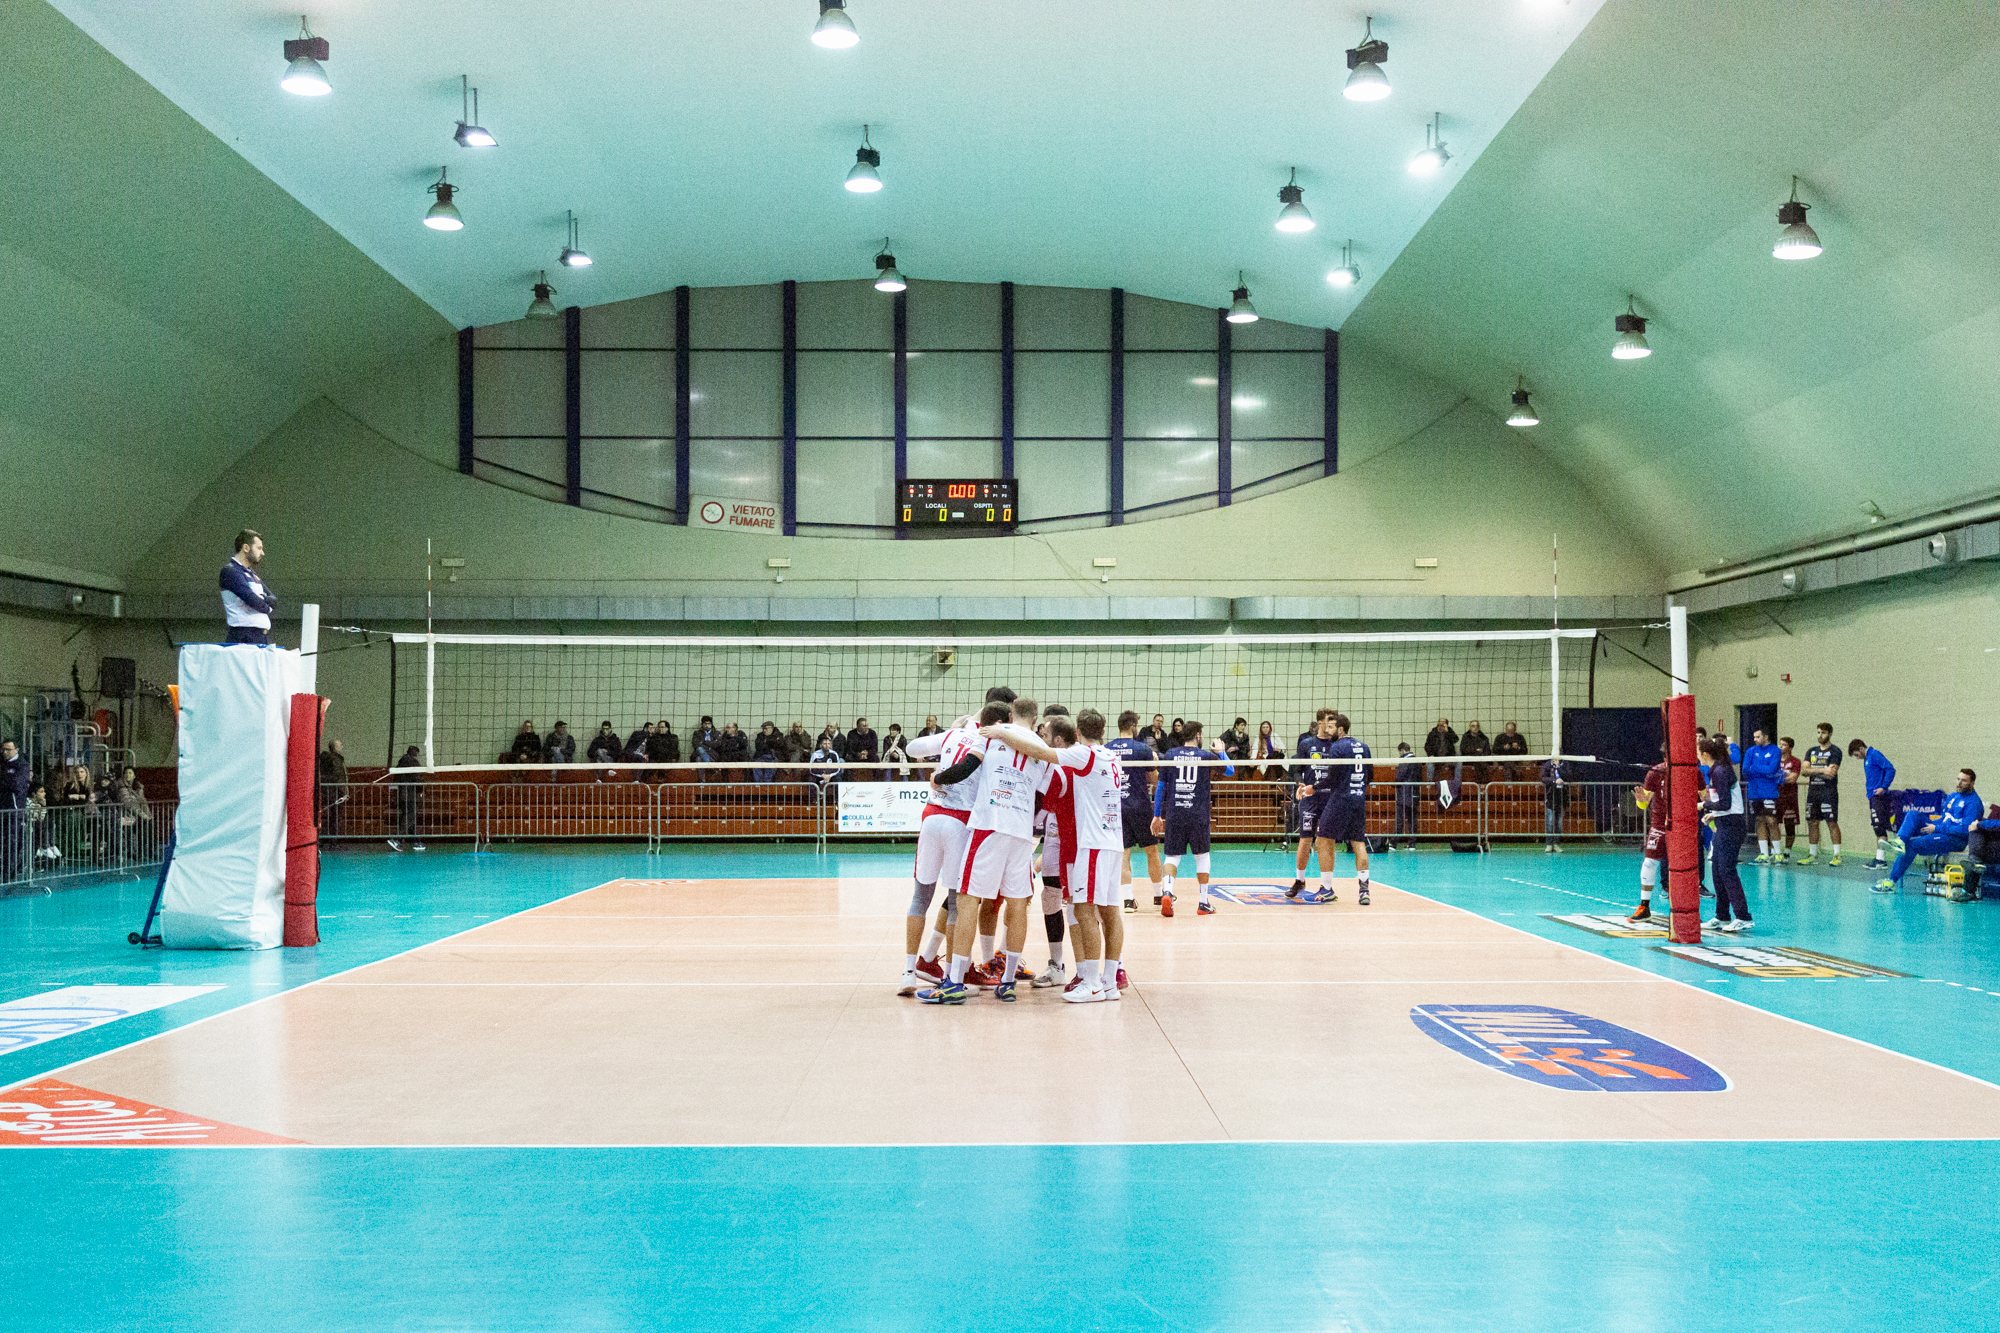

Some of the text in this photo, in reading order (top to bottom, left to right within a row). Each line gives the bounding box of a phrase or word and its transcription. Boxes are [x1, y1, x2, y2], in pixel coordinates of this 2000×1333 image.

[732, 504, 775, 517] VIETATO
[903, 508, 912, 522] 0
[939, 508, 948, 522] 0
[986, 508, 995, 522] 0
[1003, 508, 1012, 522] 0
[729, 515, 775, 529] FUMARE
[1111, 763, 1120, 788] 8
[1175, 765, 1198, 783] 10
[1435, 1011, 1613, 1045] TIM
